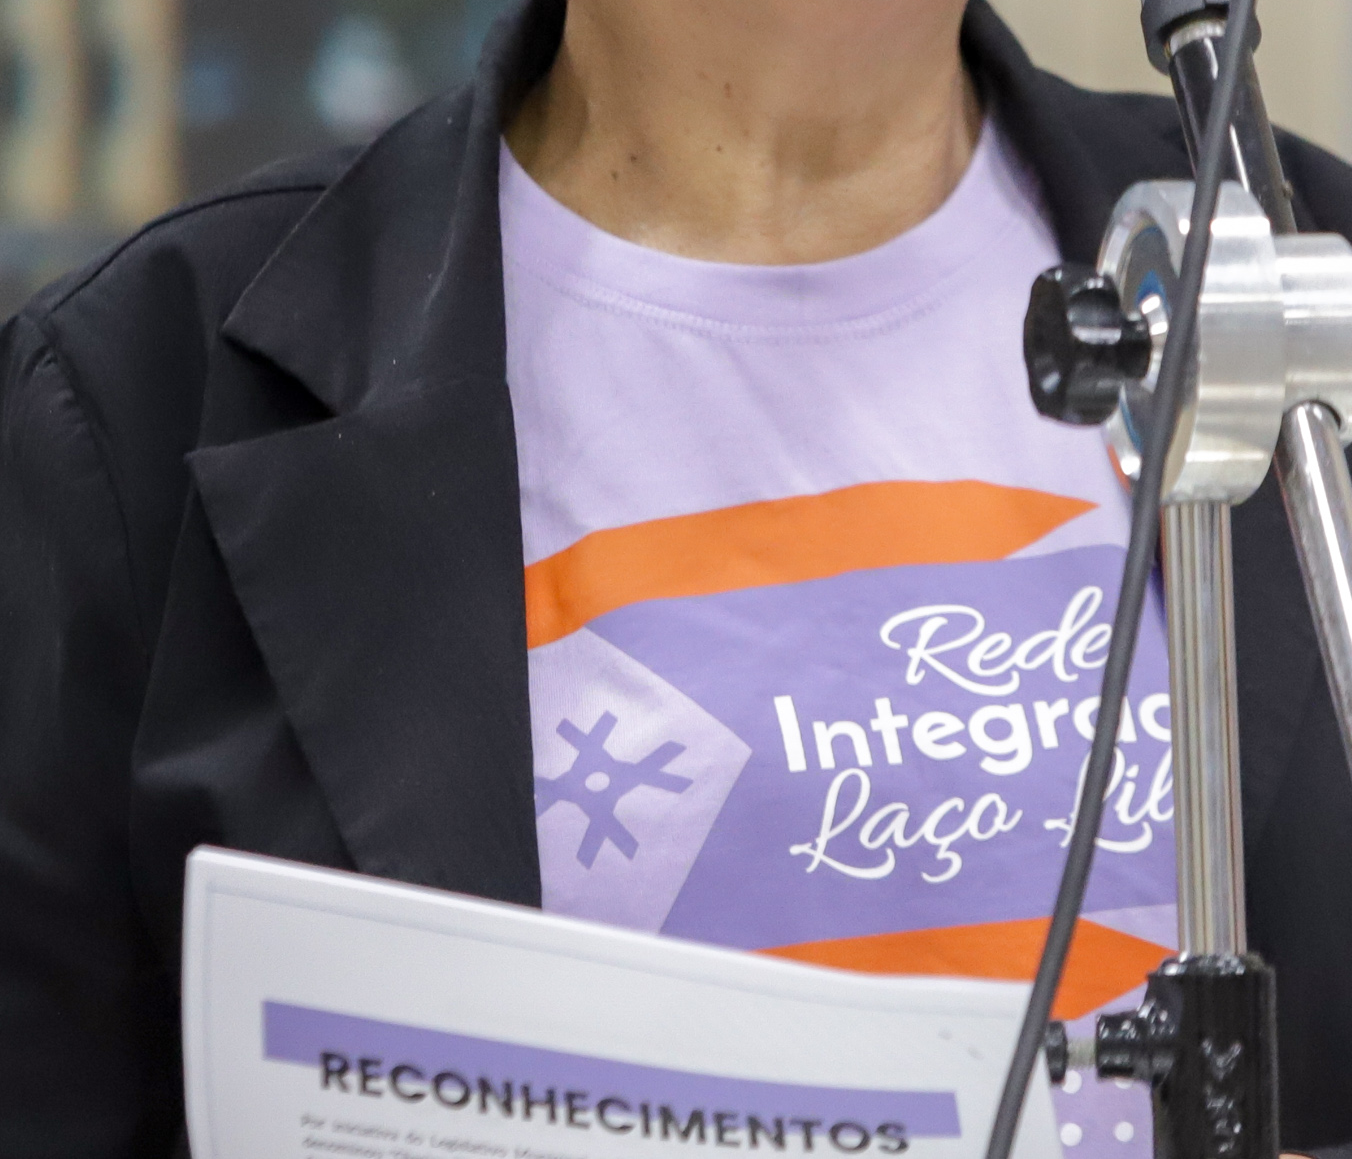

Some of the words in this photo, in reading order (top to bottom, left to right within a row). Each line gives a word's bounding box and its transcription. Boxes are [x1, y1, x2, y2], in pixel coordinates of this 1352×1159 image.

[880, 586, 1113, 696] Rede
[789, 768, 1023, 884] Laço
[319, 1051, 910, 1153] RECONHECIMENTOS
